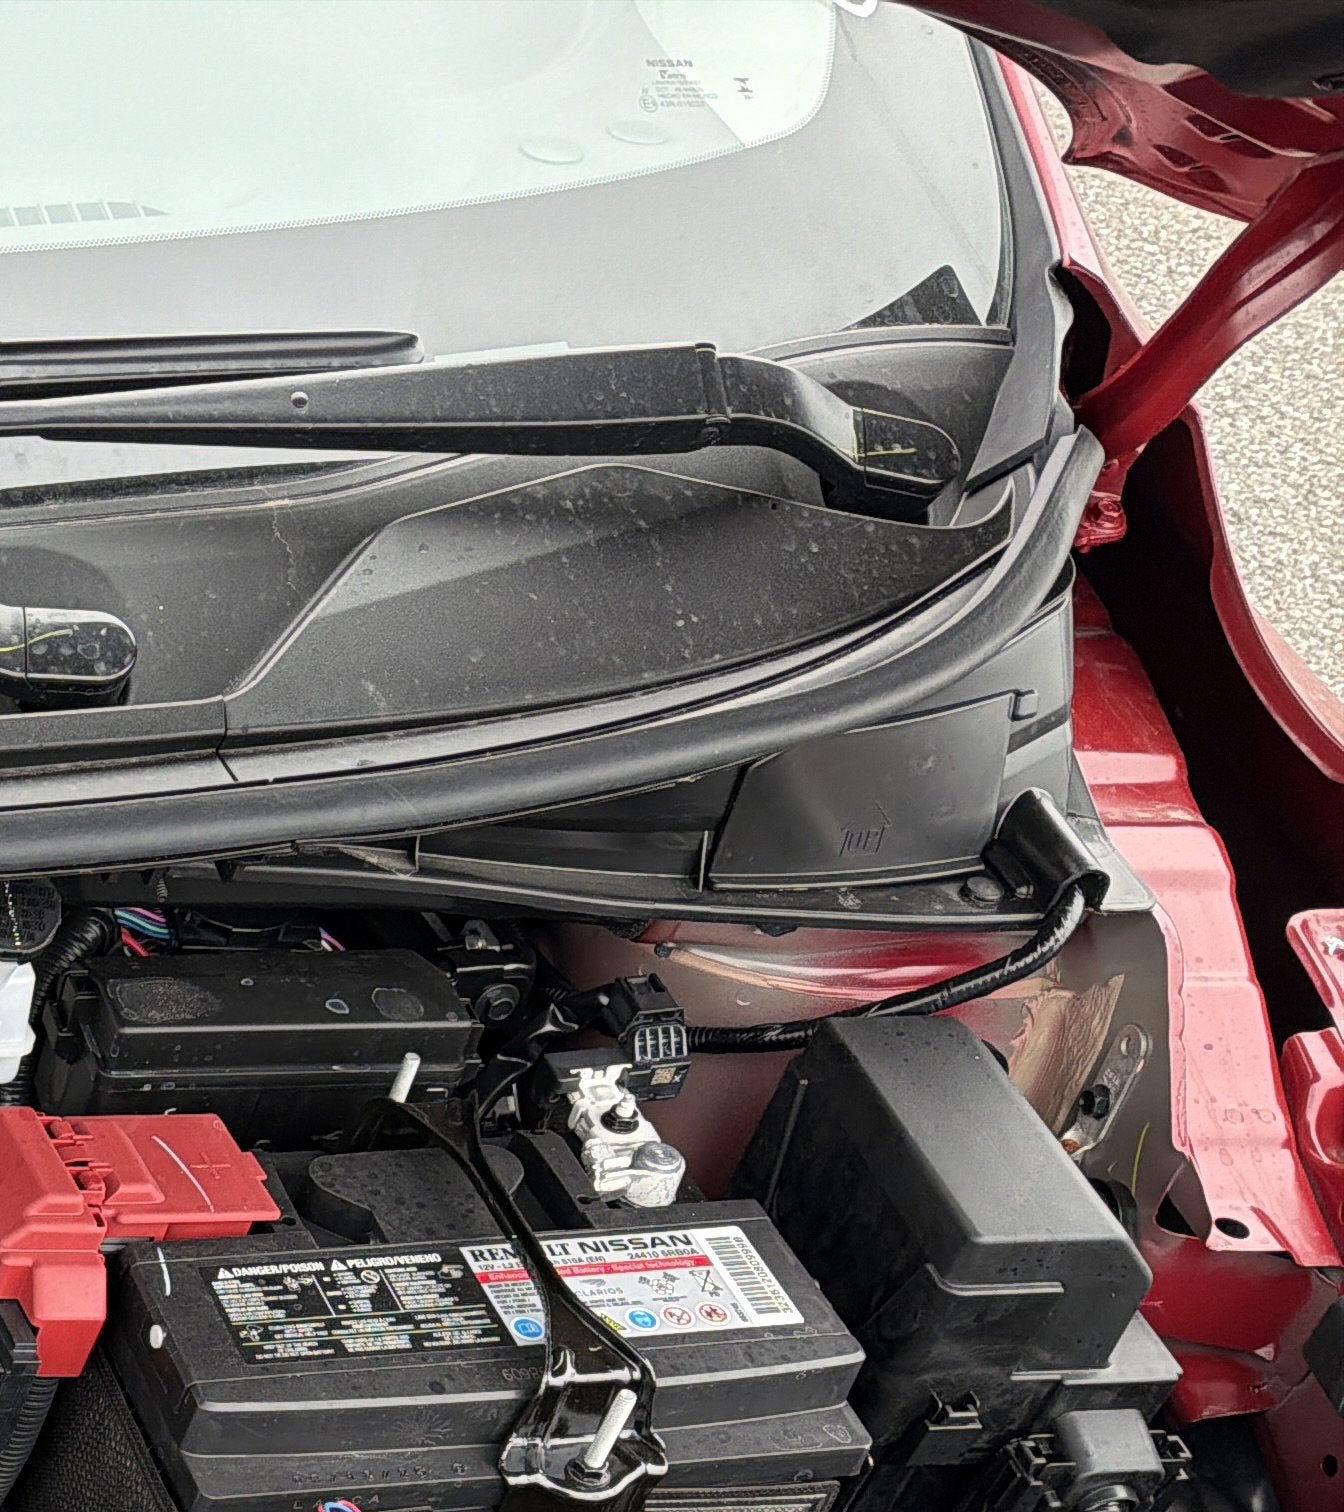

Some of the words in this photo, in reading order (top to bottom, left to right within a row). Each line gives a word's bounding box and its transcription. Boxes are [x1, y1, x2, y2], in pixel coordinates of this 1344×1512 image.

[646, 59, 693, 68] NISSAN
[579, 1233, 692, 1254] NISSAN
[345, 1253, 442, 1269] PELIGRO/VENENO
[627, 1250, 658, 1260] 24410
[232, 1261, 325, 1277] DANGER/POISON
